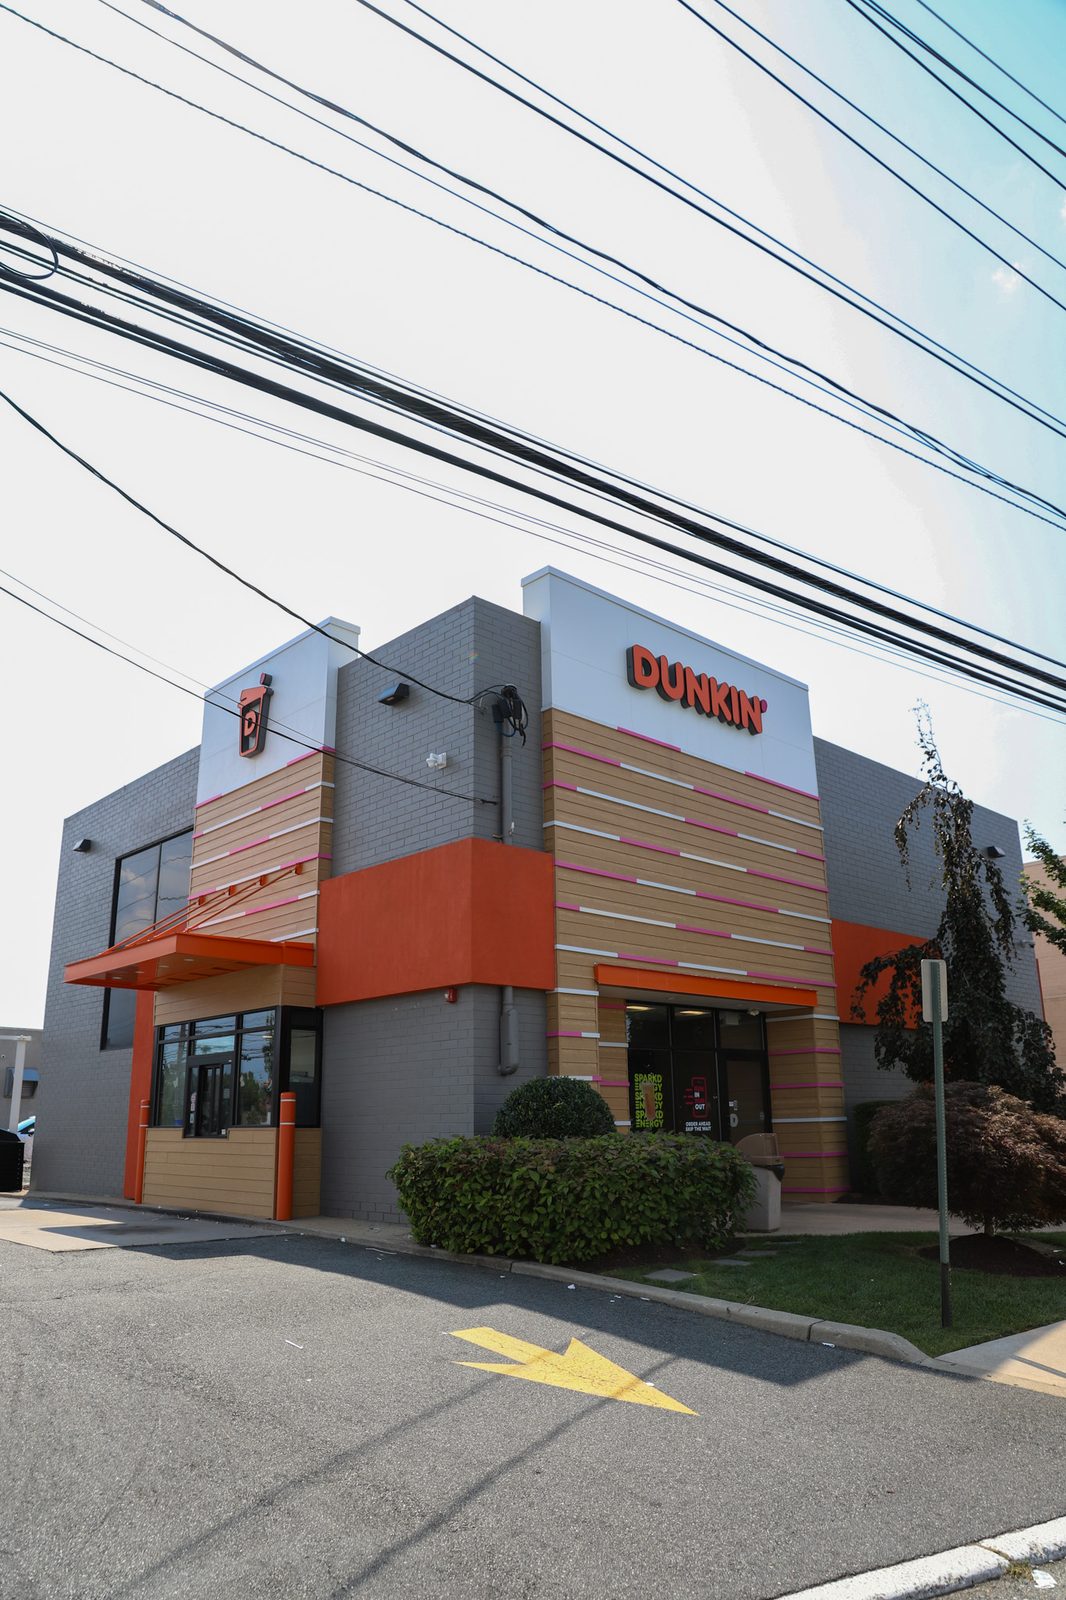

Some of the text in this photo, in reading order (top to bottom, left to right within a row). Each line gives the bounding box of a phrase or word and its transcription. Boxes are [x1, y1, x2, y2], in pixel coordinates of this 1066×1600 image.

[626, 644, 768, 736] DUNKIN'
[634, 1073, 662, 1083] SPARKD
[636, 1120, 664, 1128] ENERGY
